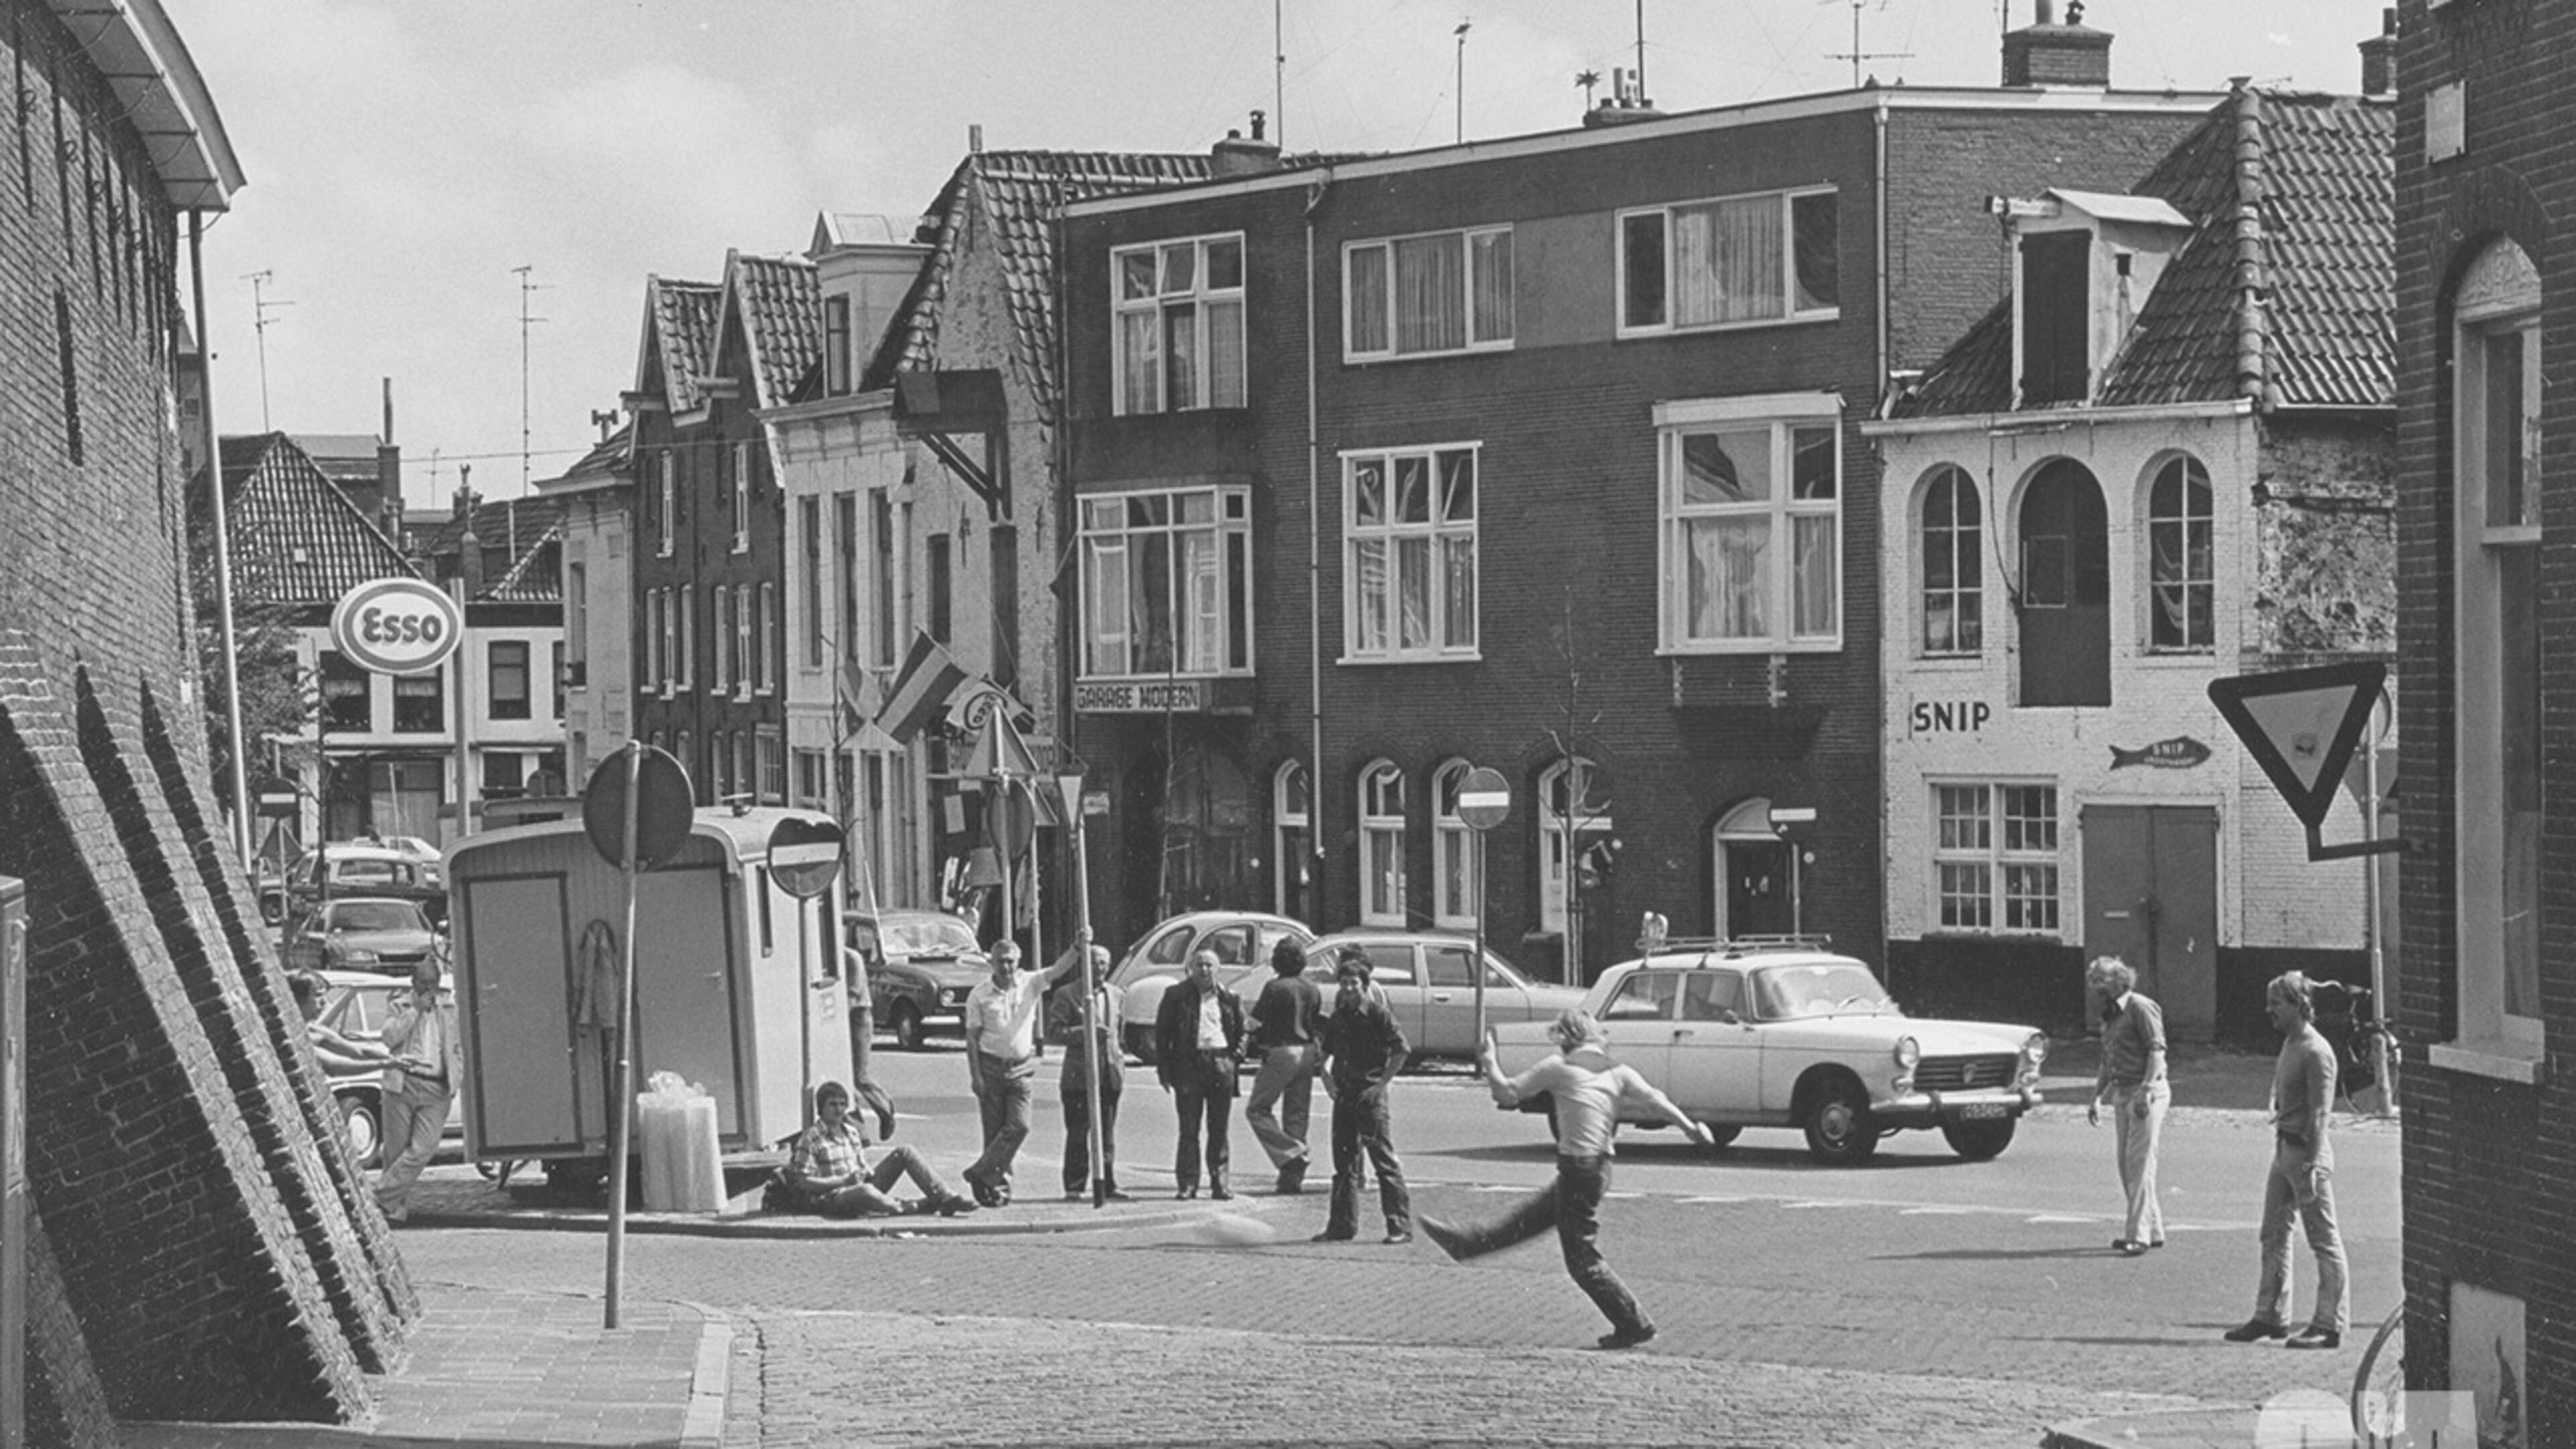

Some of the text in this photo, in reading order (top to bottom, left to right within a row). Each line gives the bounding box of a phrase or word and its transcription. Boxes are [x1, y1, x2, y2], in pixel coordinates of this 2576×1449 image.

[363, 607, 441, 643] Esso
[1077, 686, 1199, 708] GARAGE MODERN
[1914, 702, 1990, 732] SNIP
[2152, 743, 2184, 755] SNIP
